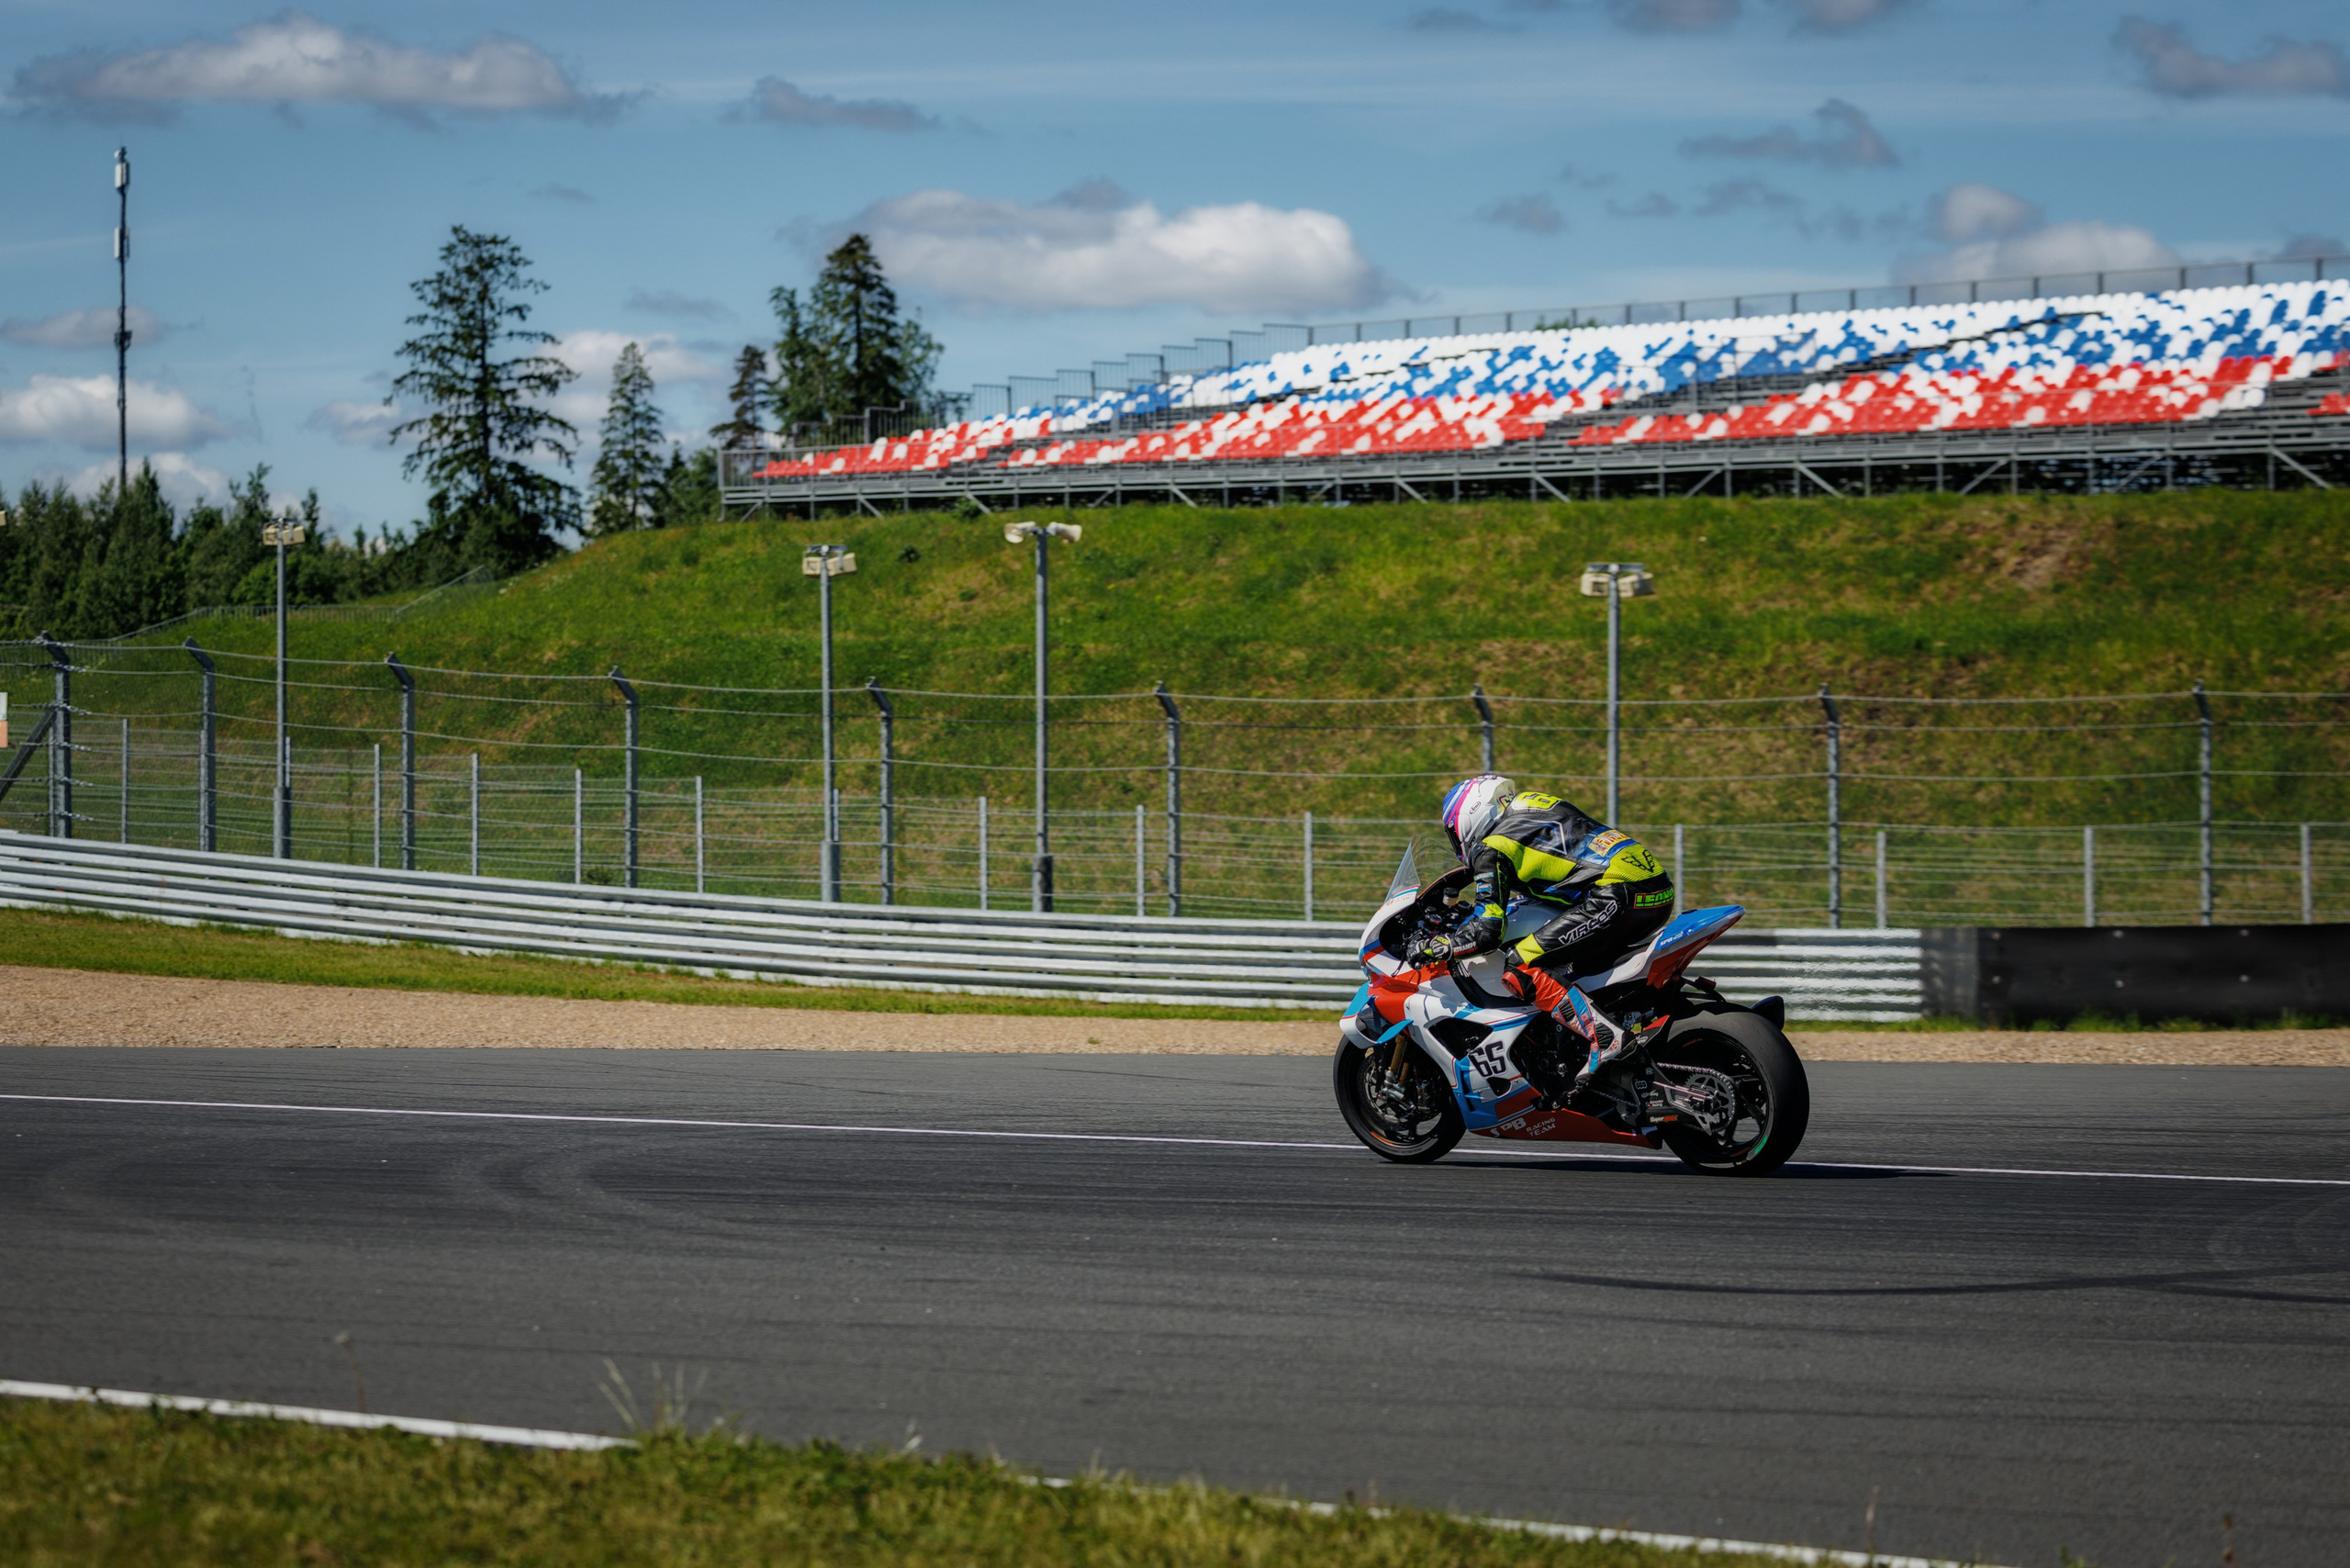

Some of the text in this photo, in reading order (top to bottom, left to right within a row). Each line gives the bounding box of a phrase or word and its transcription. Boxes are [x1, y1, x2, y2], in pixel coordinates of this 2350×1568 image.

[1558, 900, 1617, 946] VIRCOS
[1469, 1040, 1506, 1078] 65
[1490, 1117, 1527, 1137] SPB
[1526, 1117, 1556, 1133] RACING
[1529, 1123, 1556, 1137] TEAM
